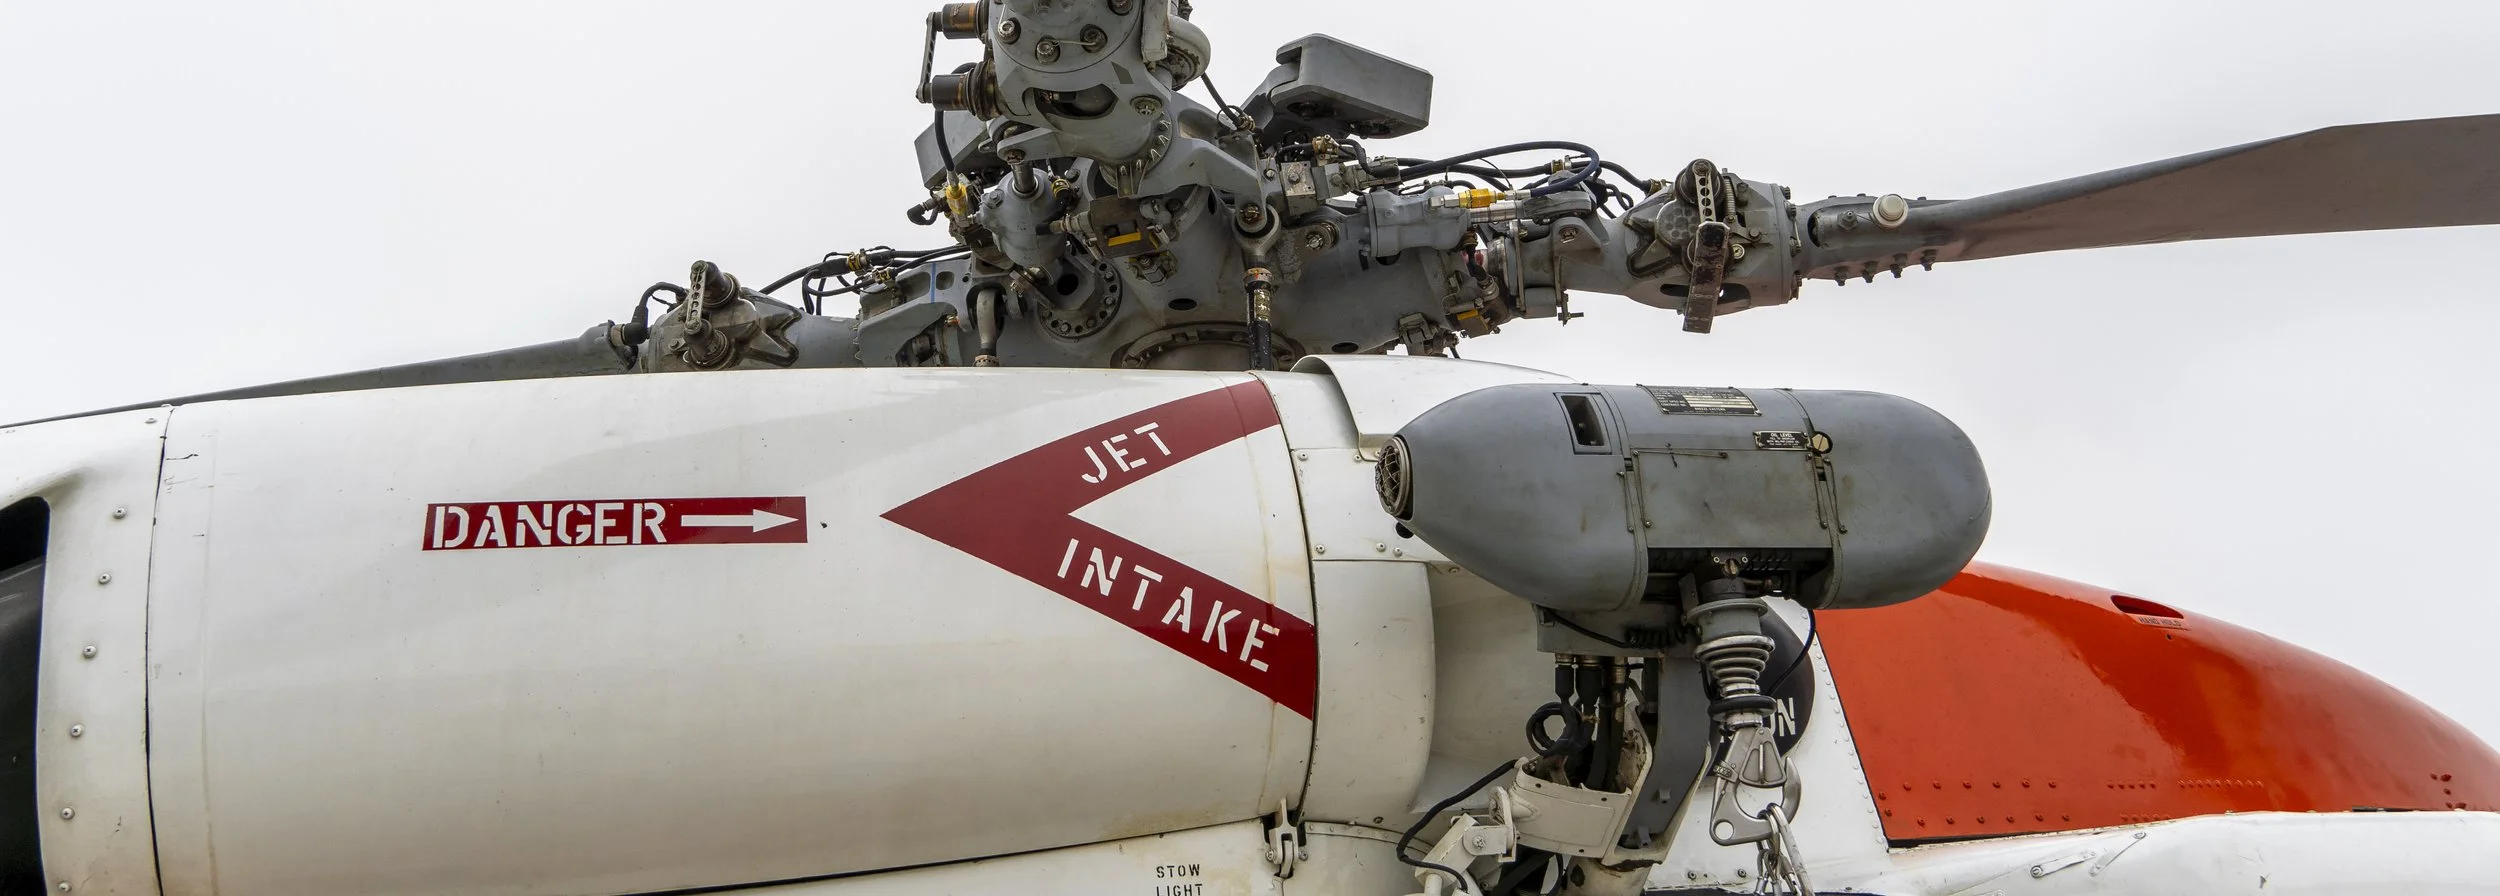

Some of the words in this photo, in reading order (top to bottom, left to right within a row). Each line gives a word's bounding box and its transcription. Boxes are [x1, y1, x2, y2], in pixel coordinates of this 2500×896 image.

[1081, 422, 1171, 483] JET
[432, 502, 667, 549] DANGER
[1057, 538, 1280, 672] INTAKE
[1156, 864, 1200, 878] STOW
[1156, 883, 1203, 896] LIGHT
